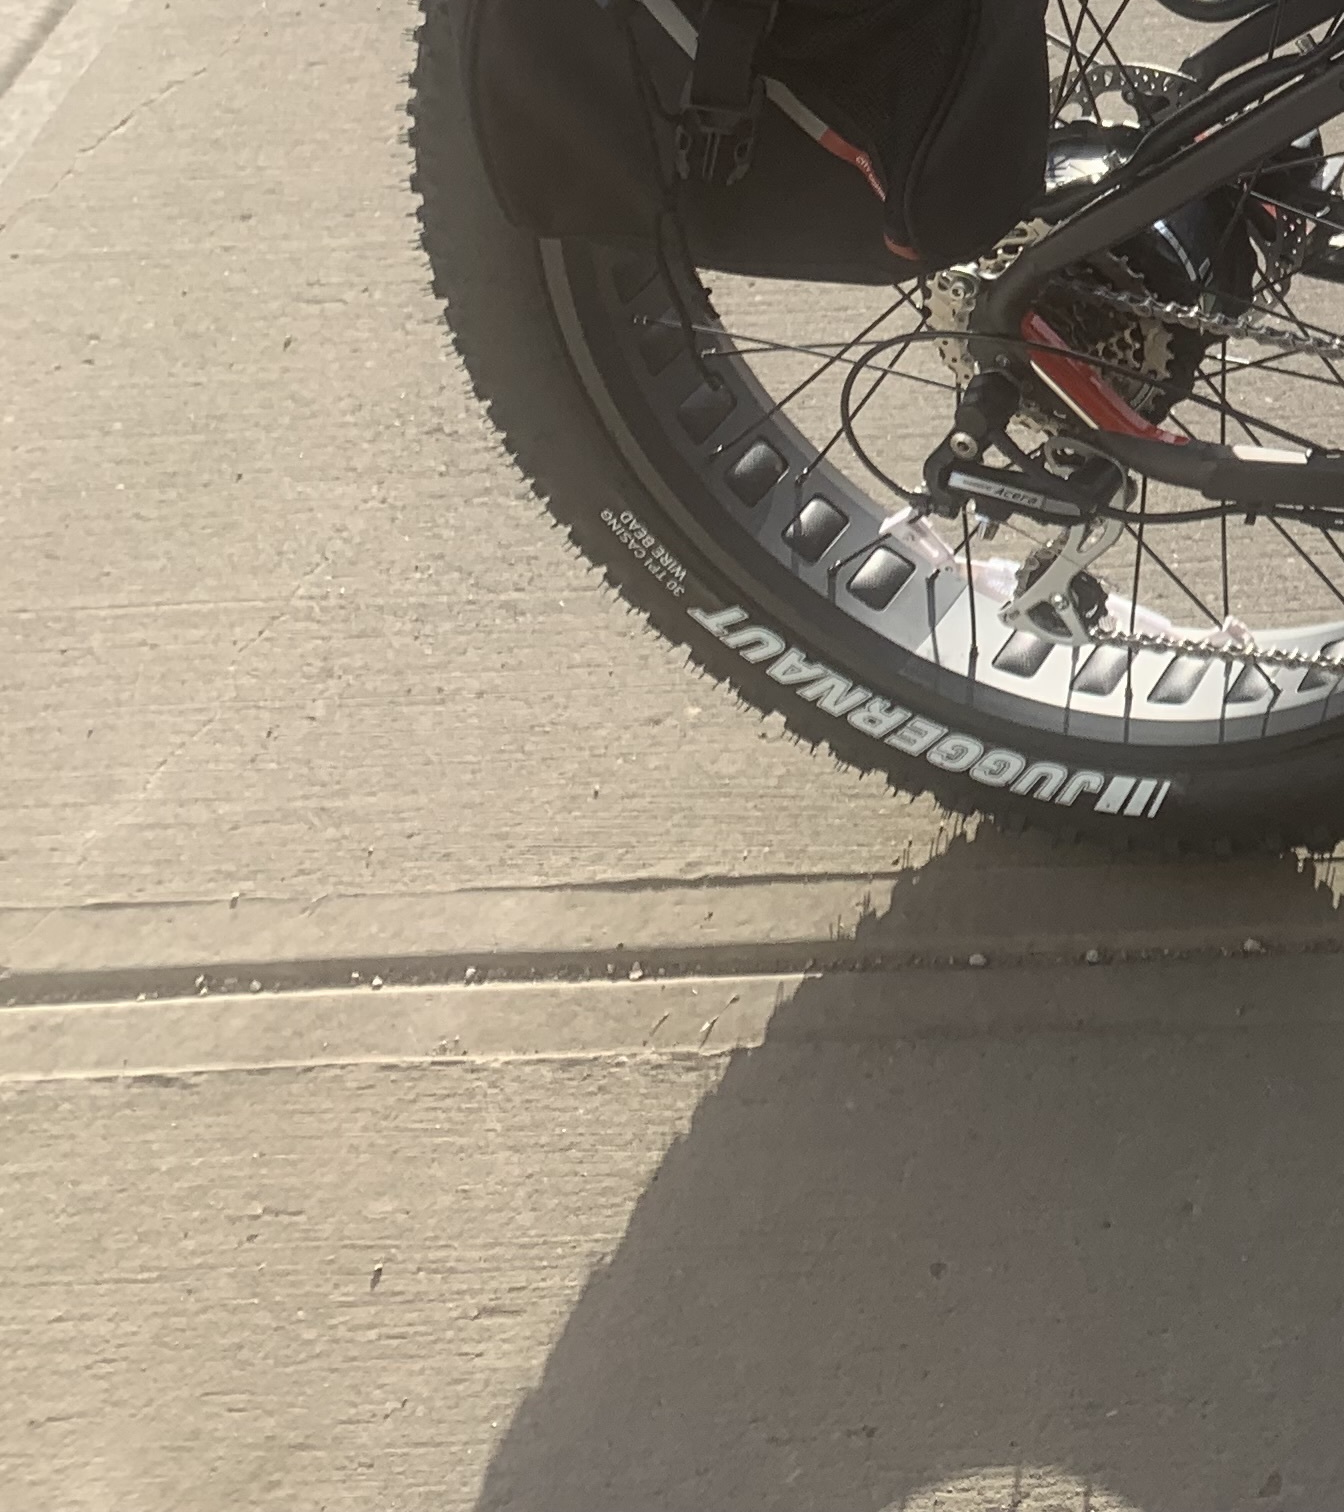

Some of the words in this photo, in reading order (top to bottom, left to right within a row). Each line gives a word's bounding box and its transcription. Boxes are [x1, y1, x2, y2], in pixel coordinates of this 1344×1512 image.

[993, 488, 1039, 505] Acera
[600, 509, 647, 559] CASING
[620, 510, 656, 549] BEAD
[644, 557, 668, 582] TPI
[651, 545, 687, 583] WIRE
[665, 579, 685, 597] 30
[686, 603, 1106, 808] JUGGERNAUT
